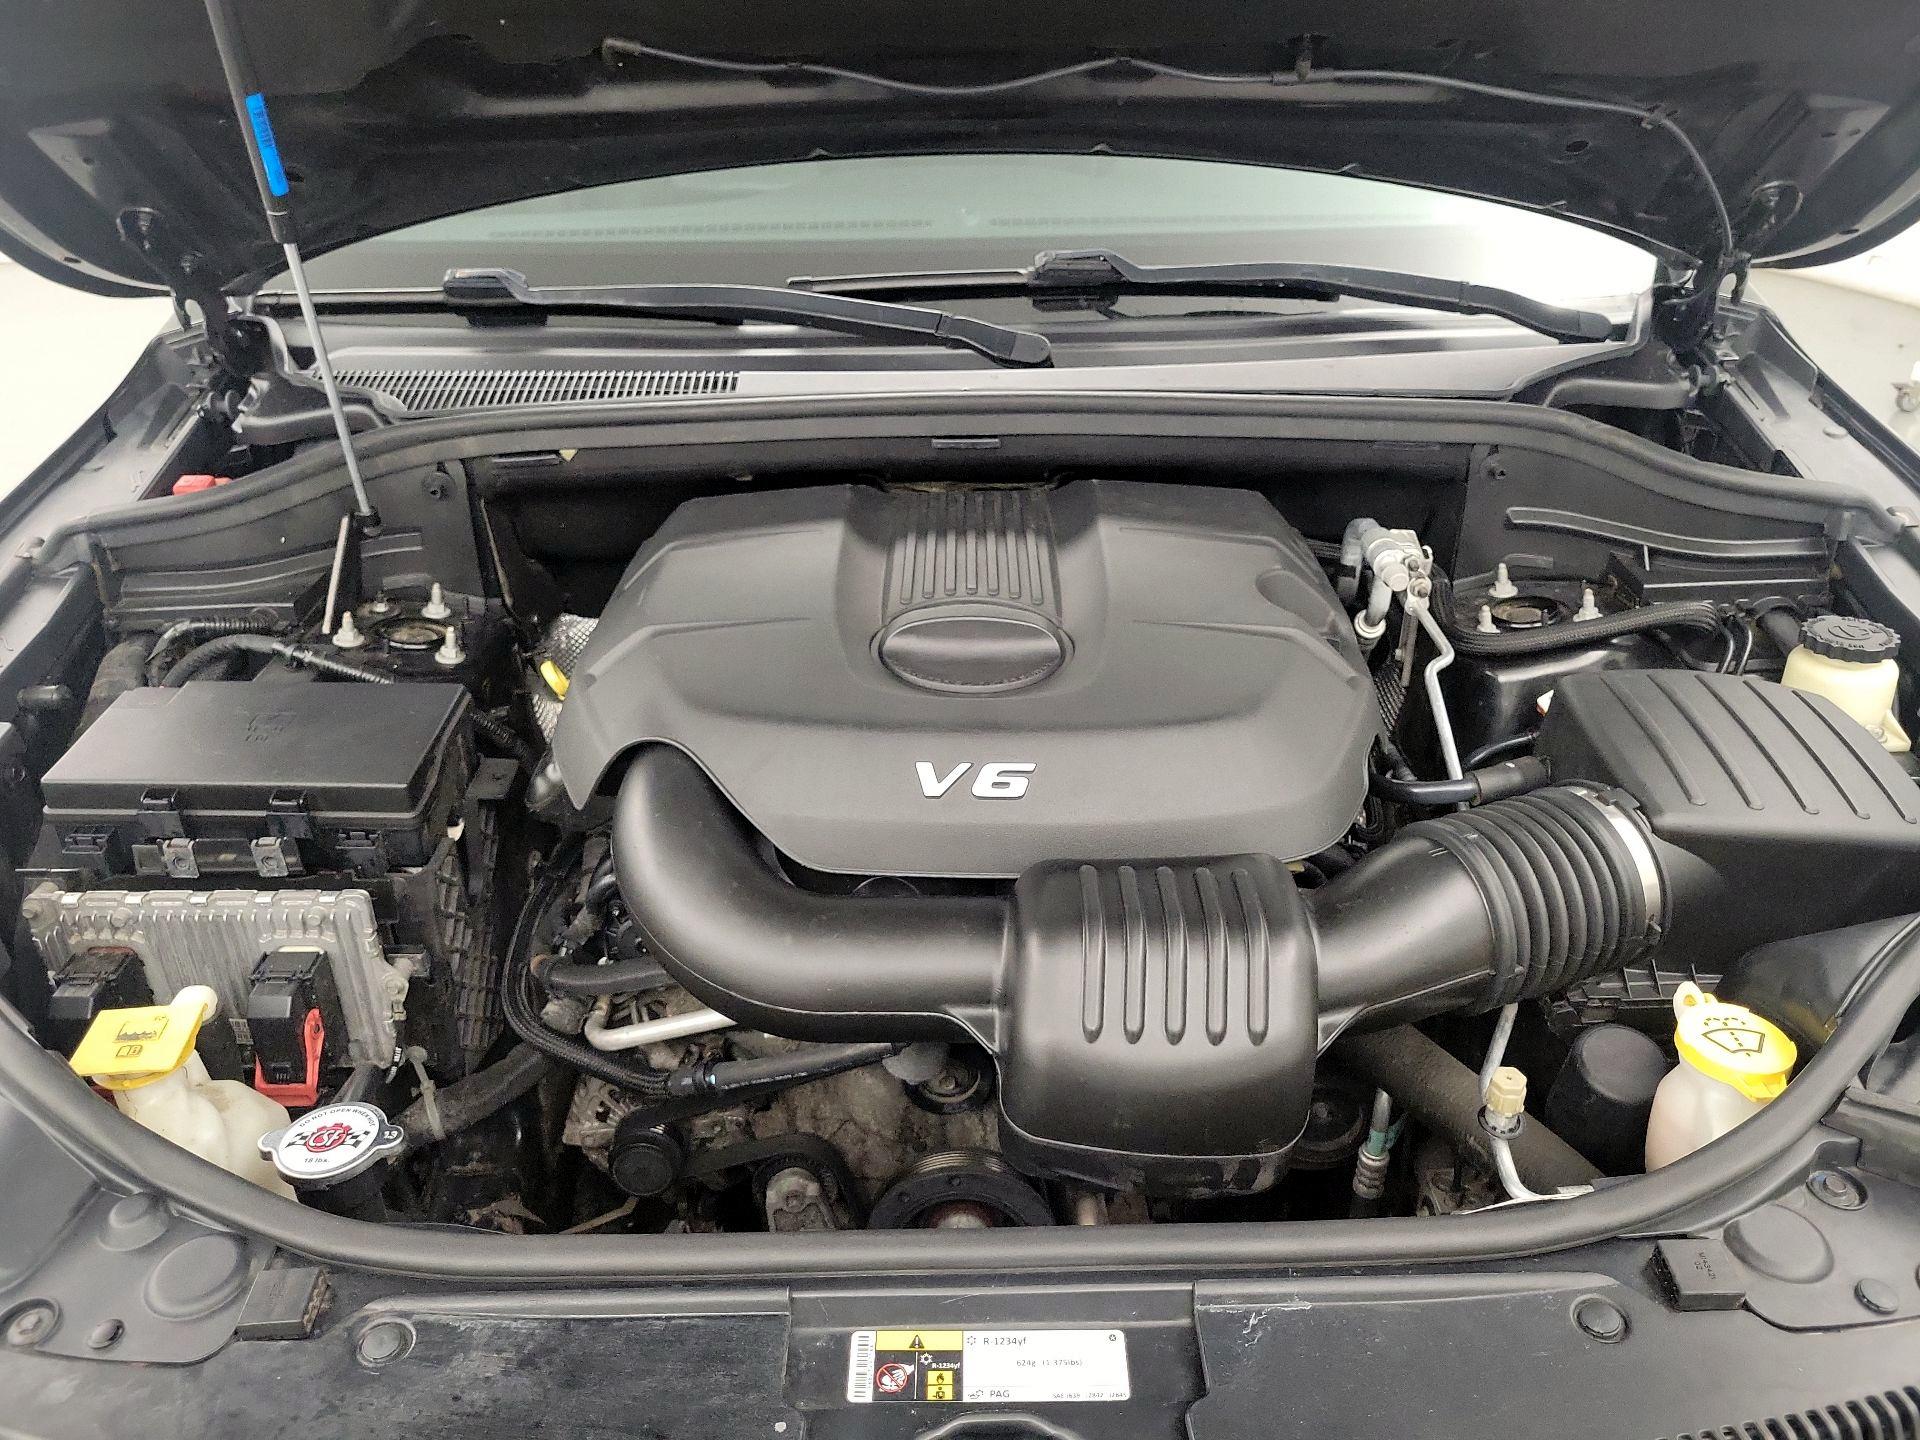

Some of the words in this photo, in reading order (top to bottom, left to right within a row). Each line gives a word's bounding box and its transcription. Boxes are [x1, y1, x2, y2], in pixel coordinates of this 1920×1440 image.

[915, 761, 1037, 800] V6
[300, 1119, 311, 1127] DO
[311, 1111, 327, 1121] NOT
[308, 1129, 345, 1147] CSF
[983, 1336, 1027, 1347] R-1234yf
[931, 1361, 961, 1370] R-1234yf
[1016, 1359, 1036, 1368] 624g
[990, 1389, 1010, 1398] PAG
